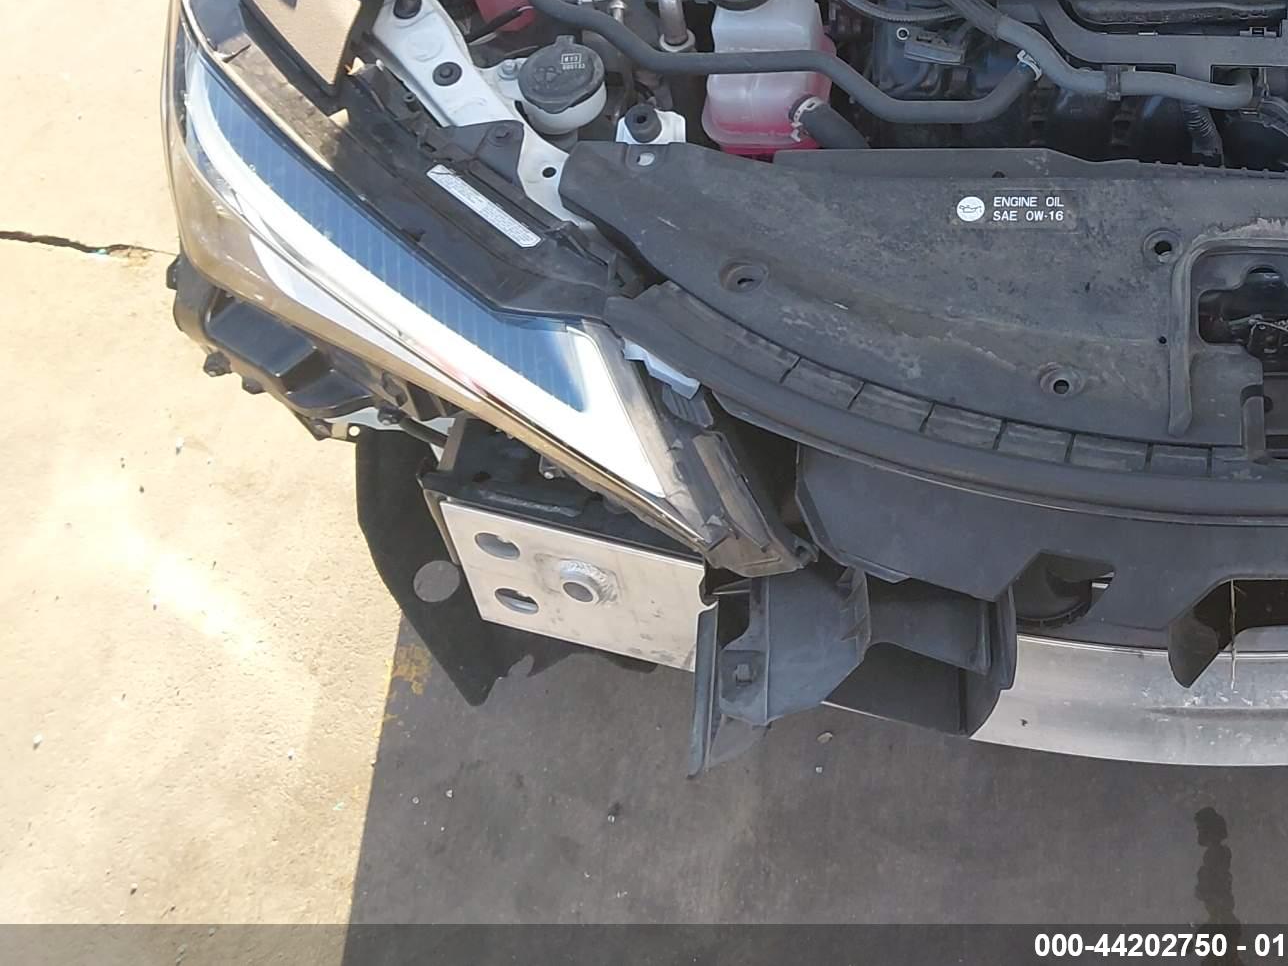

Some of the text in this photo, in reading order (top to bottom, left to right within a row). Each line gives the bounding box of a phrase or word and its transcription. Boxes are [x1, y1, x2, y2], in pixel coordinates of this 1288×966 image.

[993, 196, 1064, 208] ENGINE OIL
[992, 210, 1065, 222] SAE 0W-16
